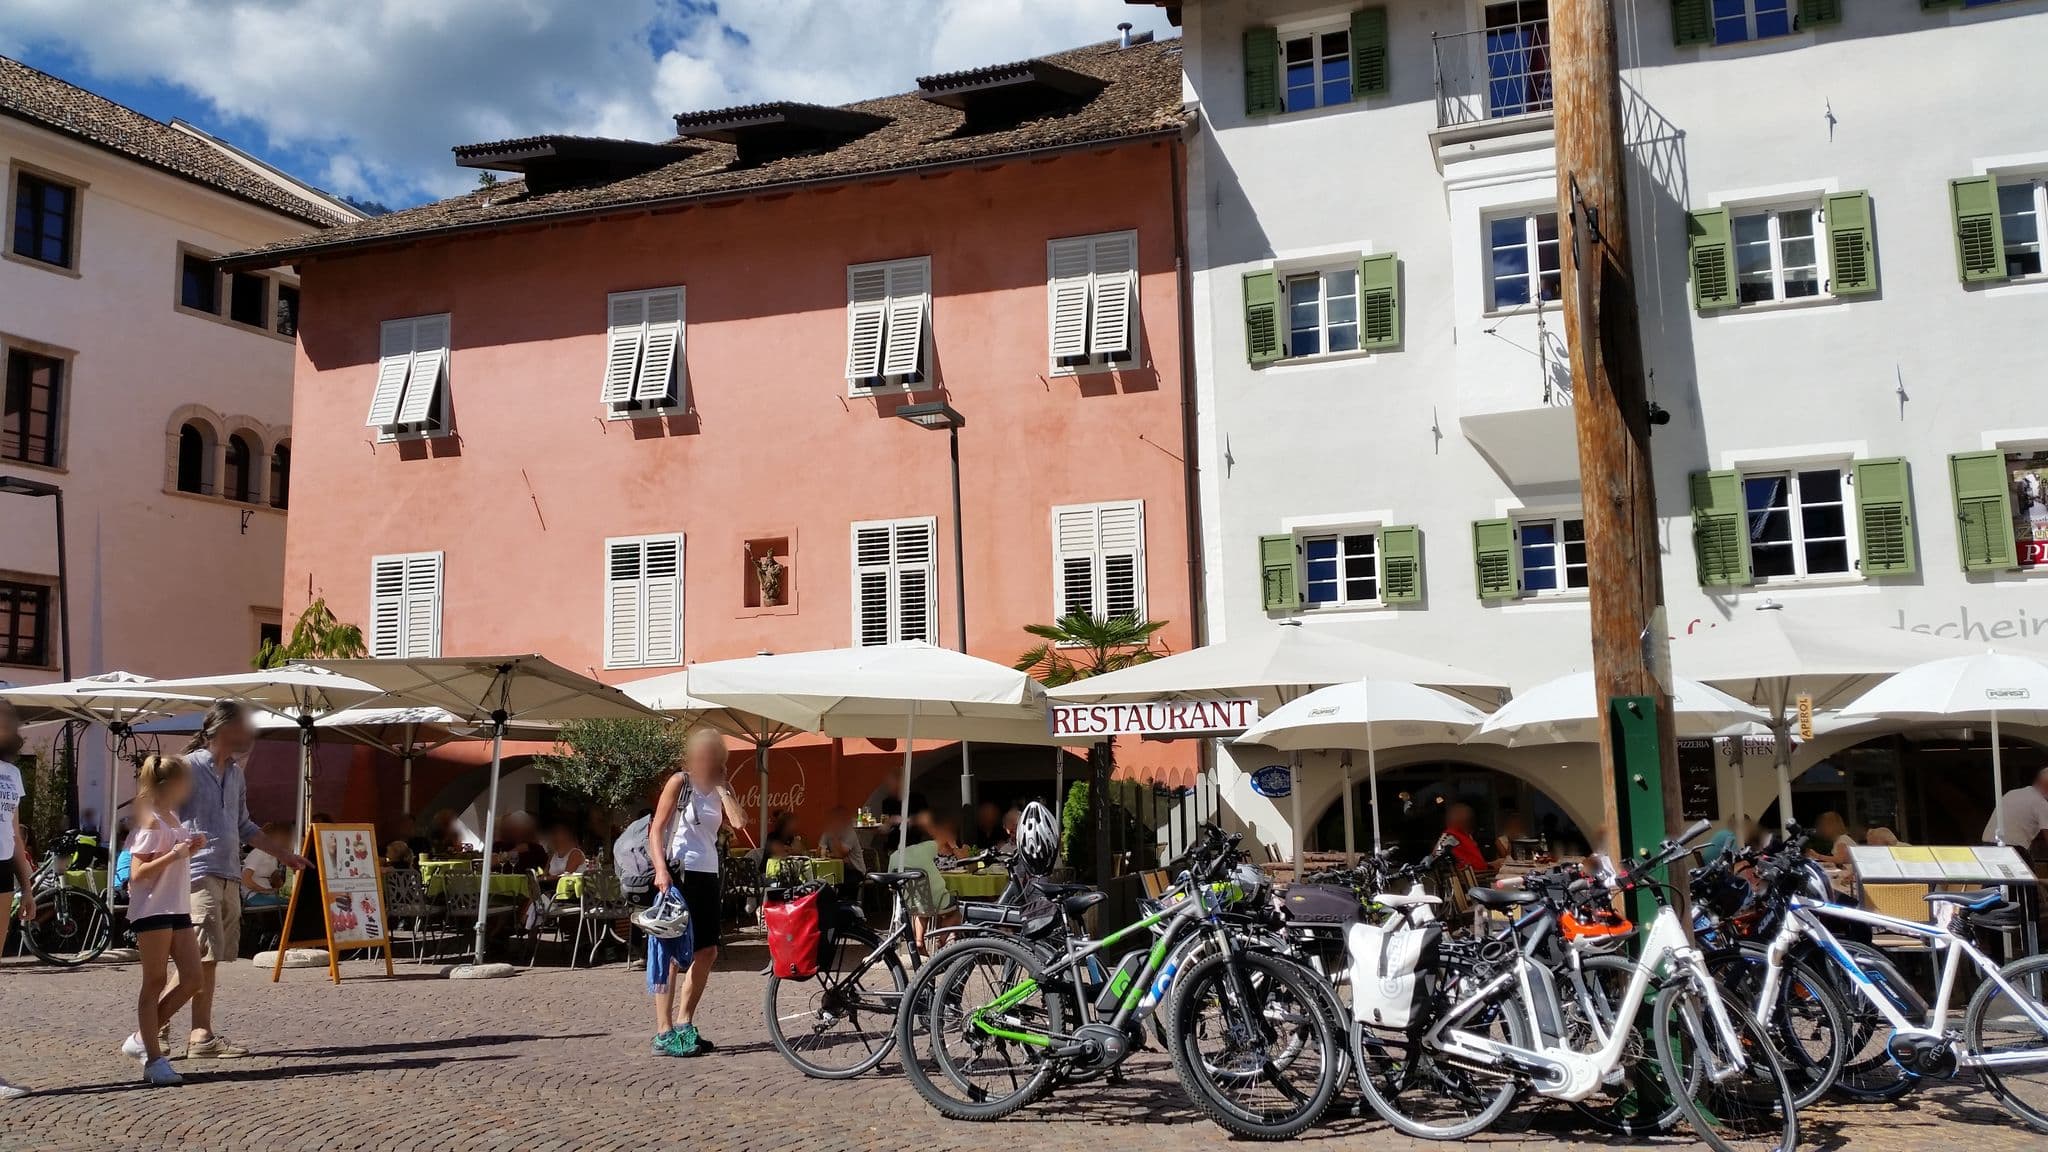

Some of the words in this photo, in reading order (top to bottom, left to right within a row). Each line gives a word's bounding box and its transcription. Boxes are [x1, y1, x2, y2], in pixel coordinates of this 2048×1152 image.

[1053, 700, 1252, 735] RESTAURANT
[1800, 698, 1811, 738] APEROL
[1723, 747, 1772, 756] GRTEN
